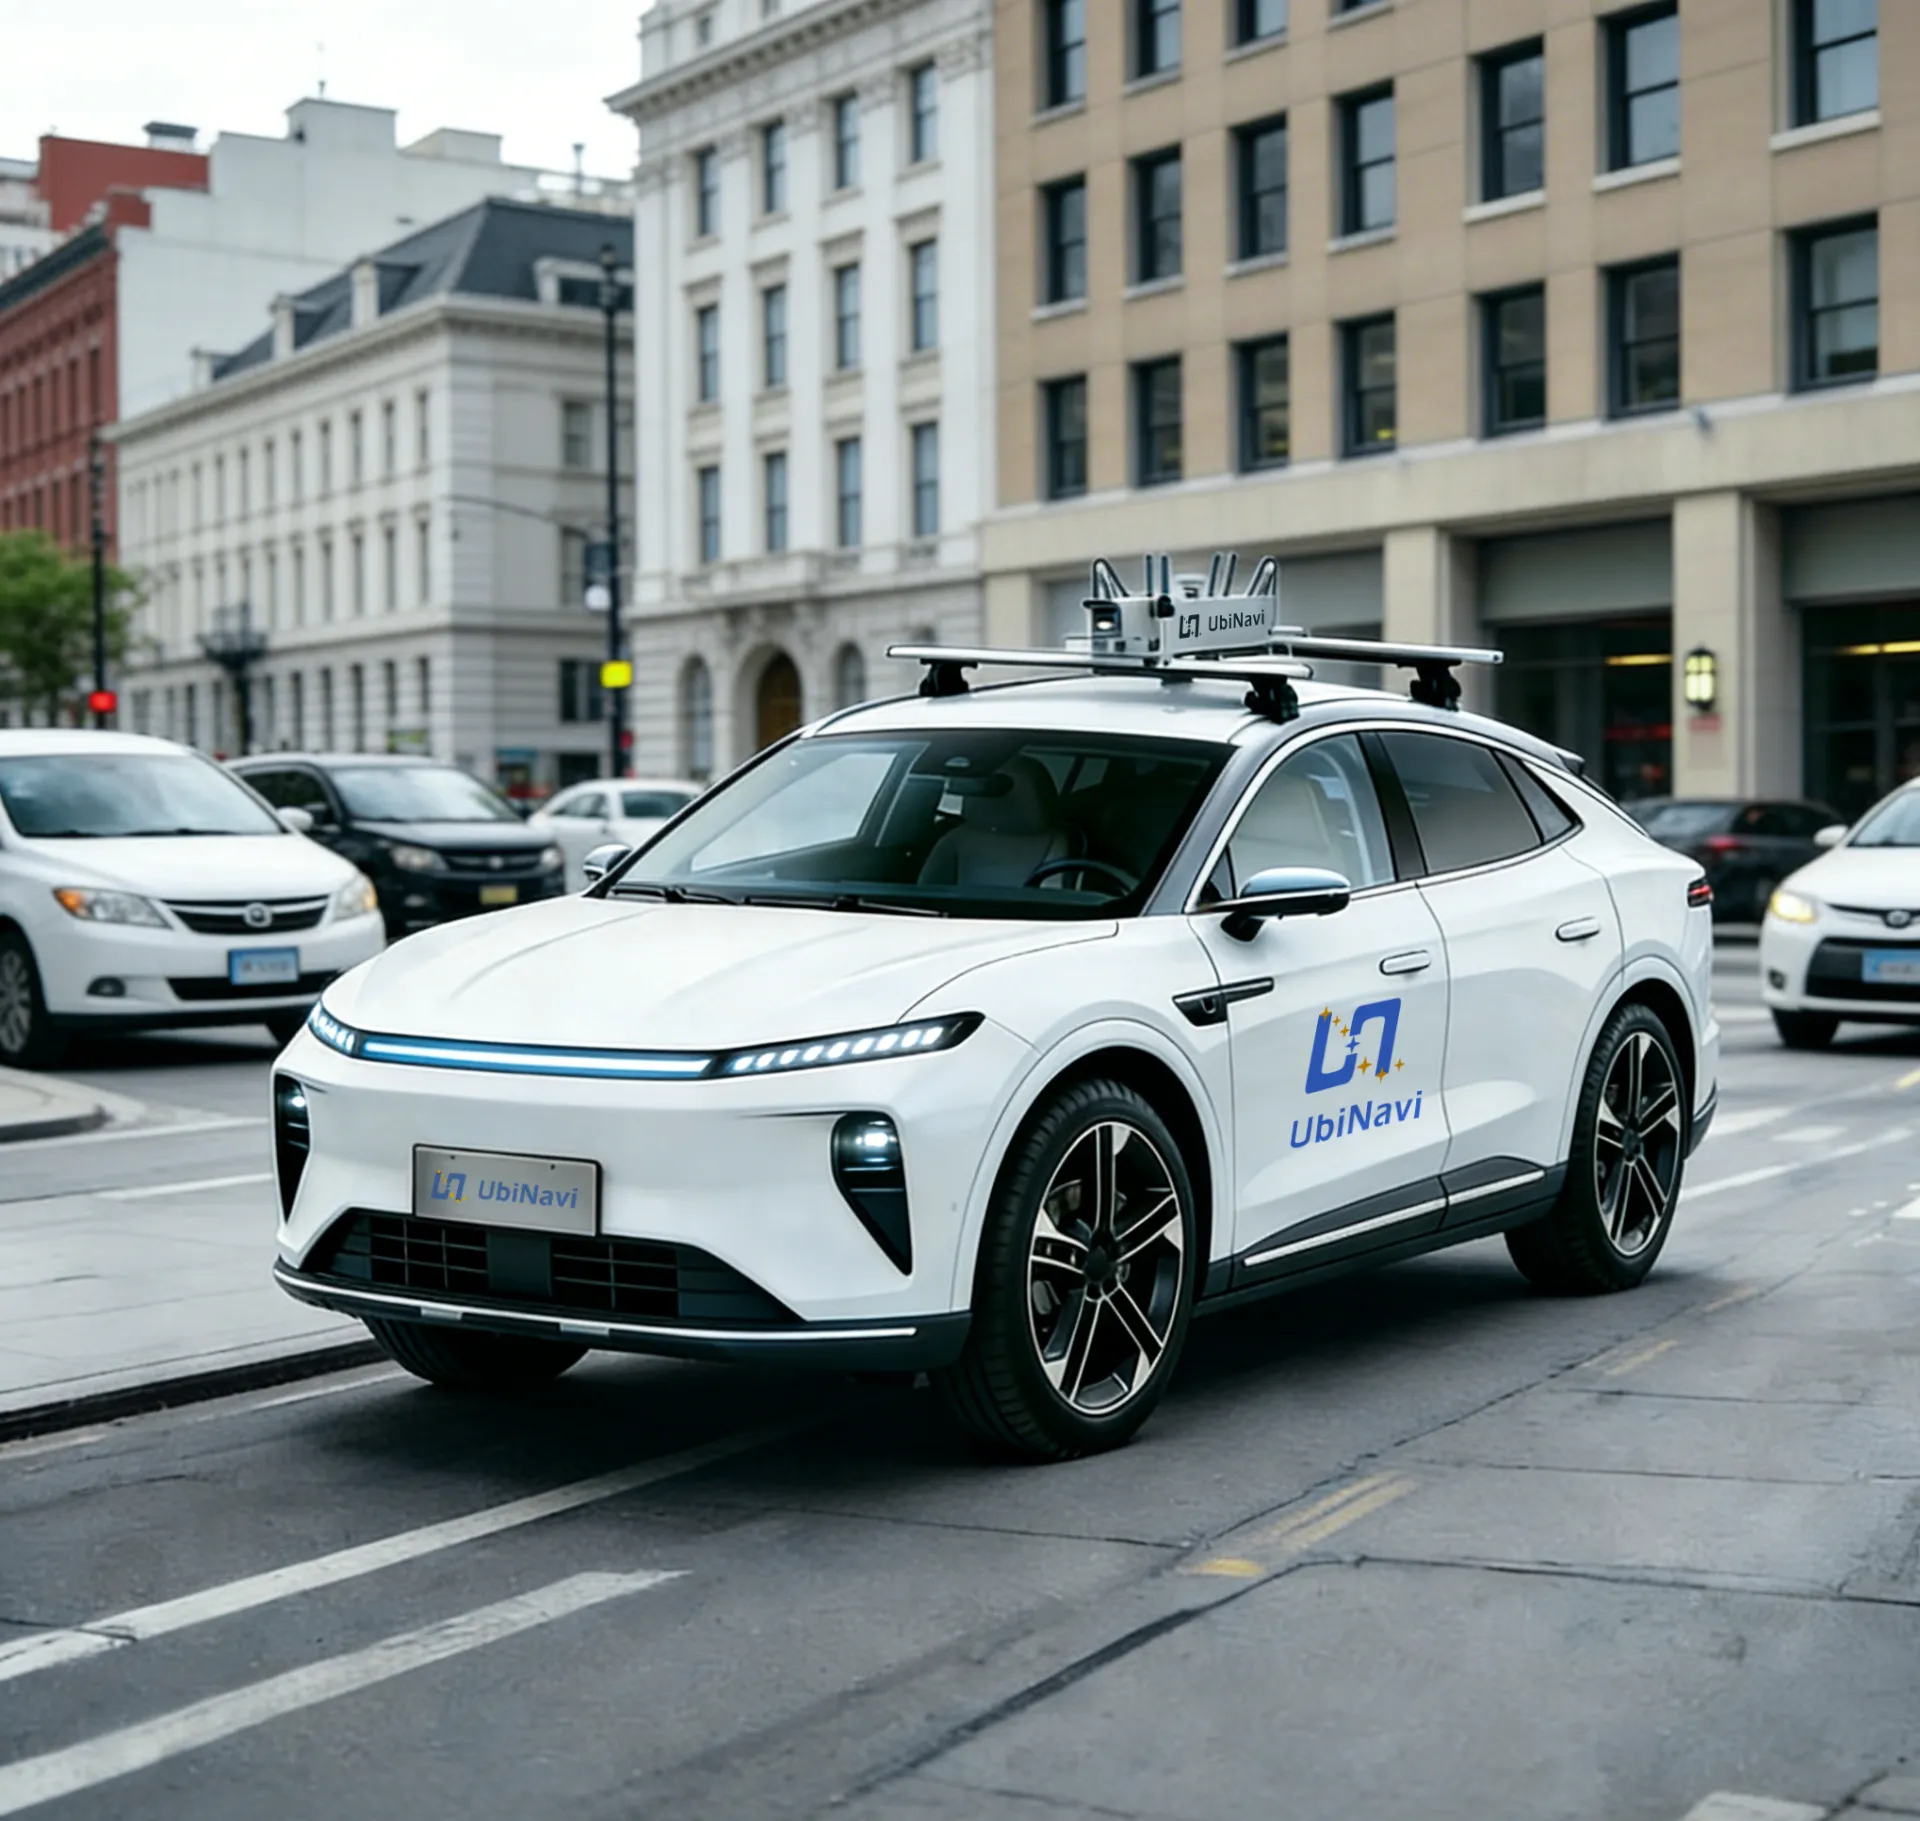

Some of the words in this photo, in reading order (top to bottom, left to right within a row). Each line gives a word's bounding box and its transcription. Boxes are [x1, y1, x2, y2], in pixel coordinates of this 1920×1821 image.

[1208, 609, 1265, 632] UbiNavi
[1290, 1090, 1423, 1149] UbiNavi
[478, 1179, 578, 1209] UbiNavi
